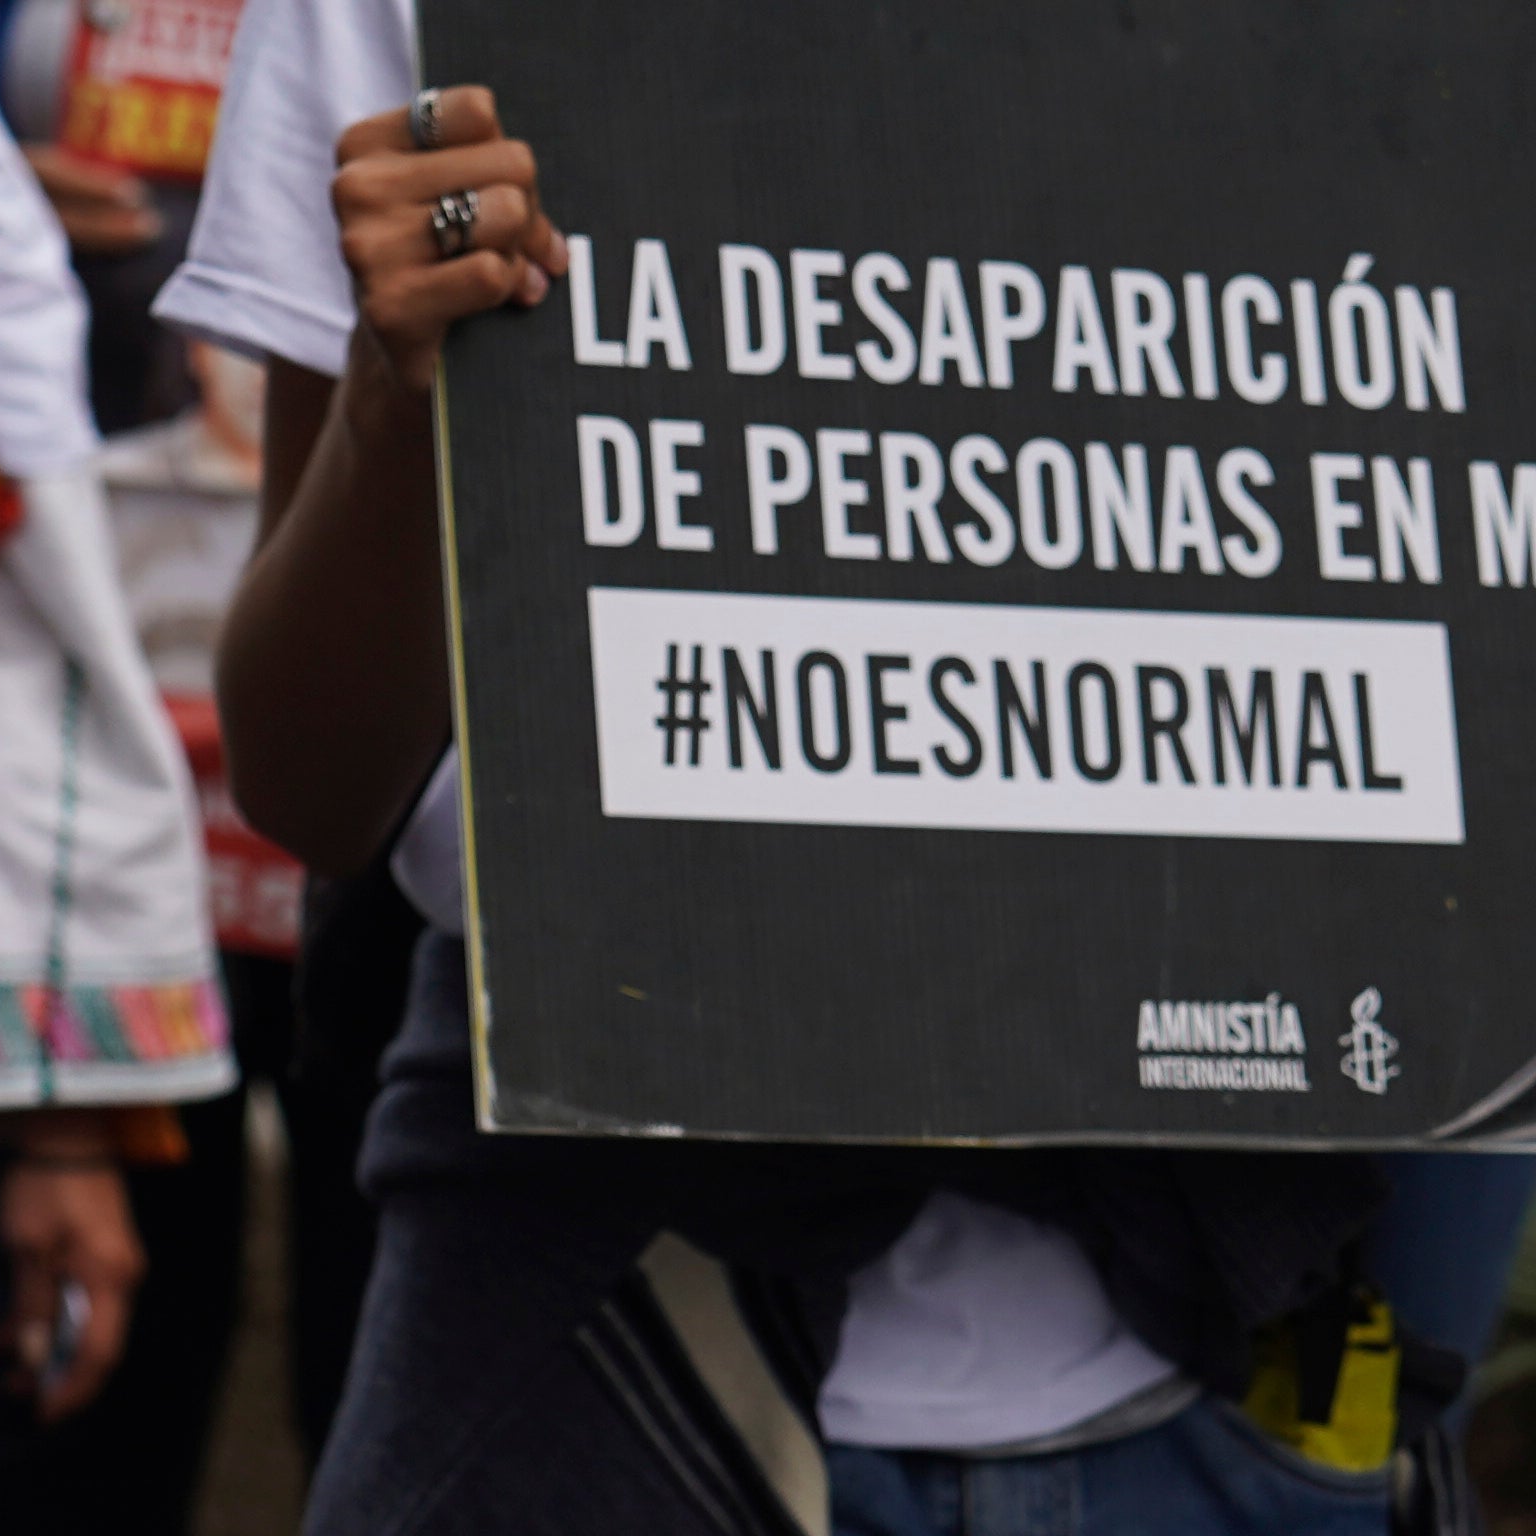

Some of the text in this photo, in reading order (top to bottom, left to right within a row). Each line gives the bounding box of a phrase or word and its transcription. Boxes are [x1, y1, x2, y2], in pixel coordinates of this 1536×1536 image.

[565, 234, 1465, 413] LA DESAPARICIÓN
[576, 415, 714, 552] DE
[744, 424, 1281, 578] PERSONAS
[1309, 453, 1441, 585] EN
[655, 643, 1404, 792] #NOESNORMAL
[1136, 991, 1307, 1053] AMNISTÍA
[1138, 1055, 1312, 1092] INTERNACIONAL
